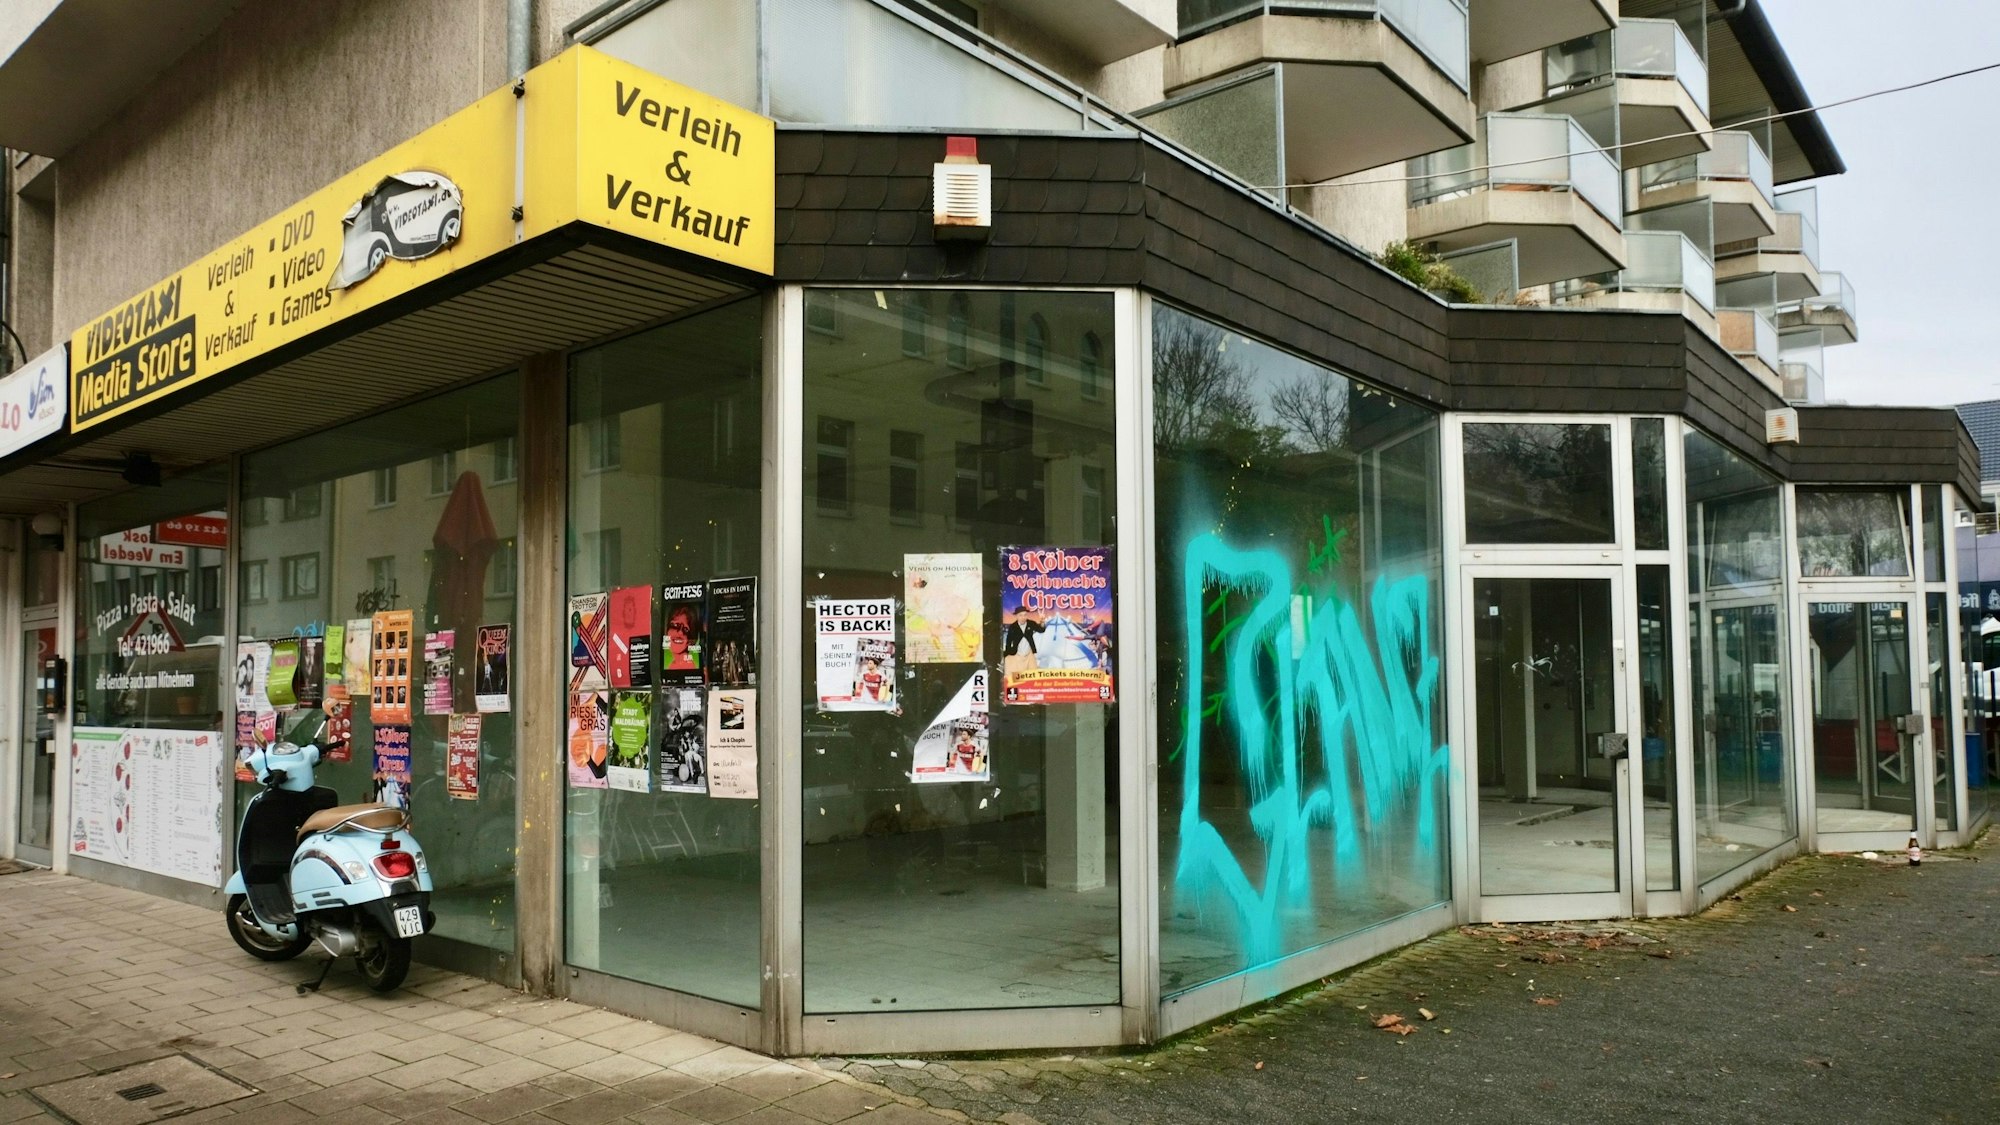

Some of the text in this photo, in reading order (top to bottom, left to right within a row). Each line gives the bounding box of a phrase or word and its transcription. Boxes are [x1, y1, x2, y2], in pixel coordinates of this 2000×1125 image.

[615, 79, 742, 158] Verleih
[665, 150, 692, 186] &
[606, 173, 751, 247] Verkauf
[281, 209, 315, 253] DVD
[207, 244, 255, 292] Verleih
[282, 247, 326, 289] Video
[85, 274, 183, 365] VIDEOTAXI
[224, 289, 234, 318] &
[281, 288, 332, 326] Games
[204, 312, 258, 362] Verkauf
[78, 332, 193, 418] Media Store
[1007, 574, 1108, 589] Weihnachts
[97, 591, 196, 637] Pizza Pasta Salat
[819, 604, 891, 616] HECTOR
[1021, 590, 1096, 610] Circus
[820, 620, 891, 632] IS BACK!
[134, 632, 170, 656] 421966
[158, 669, 195, 688] Mitnehmen
[1015, 671, 1036, 680] Jetzt
[1069, 670, 1102, 679] sichern!
[570, 695, 580, 706] IM
[580, 718, 606, 731] GRAS
[399, 909, 419, 922] 429
